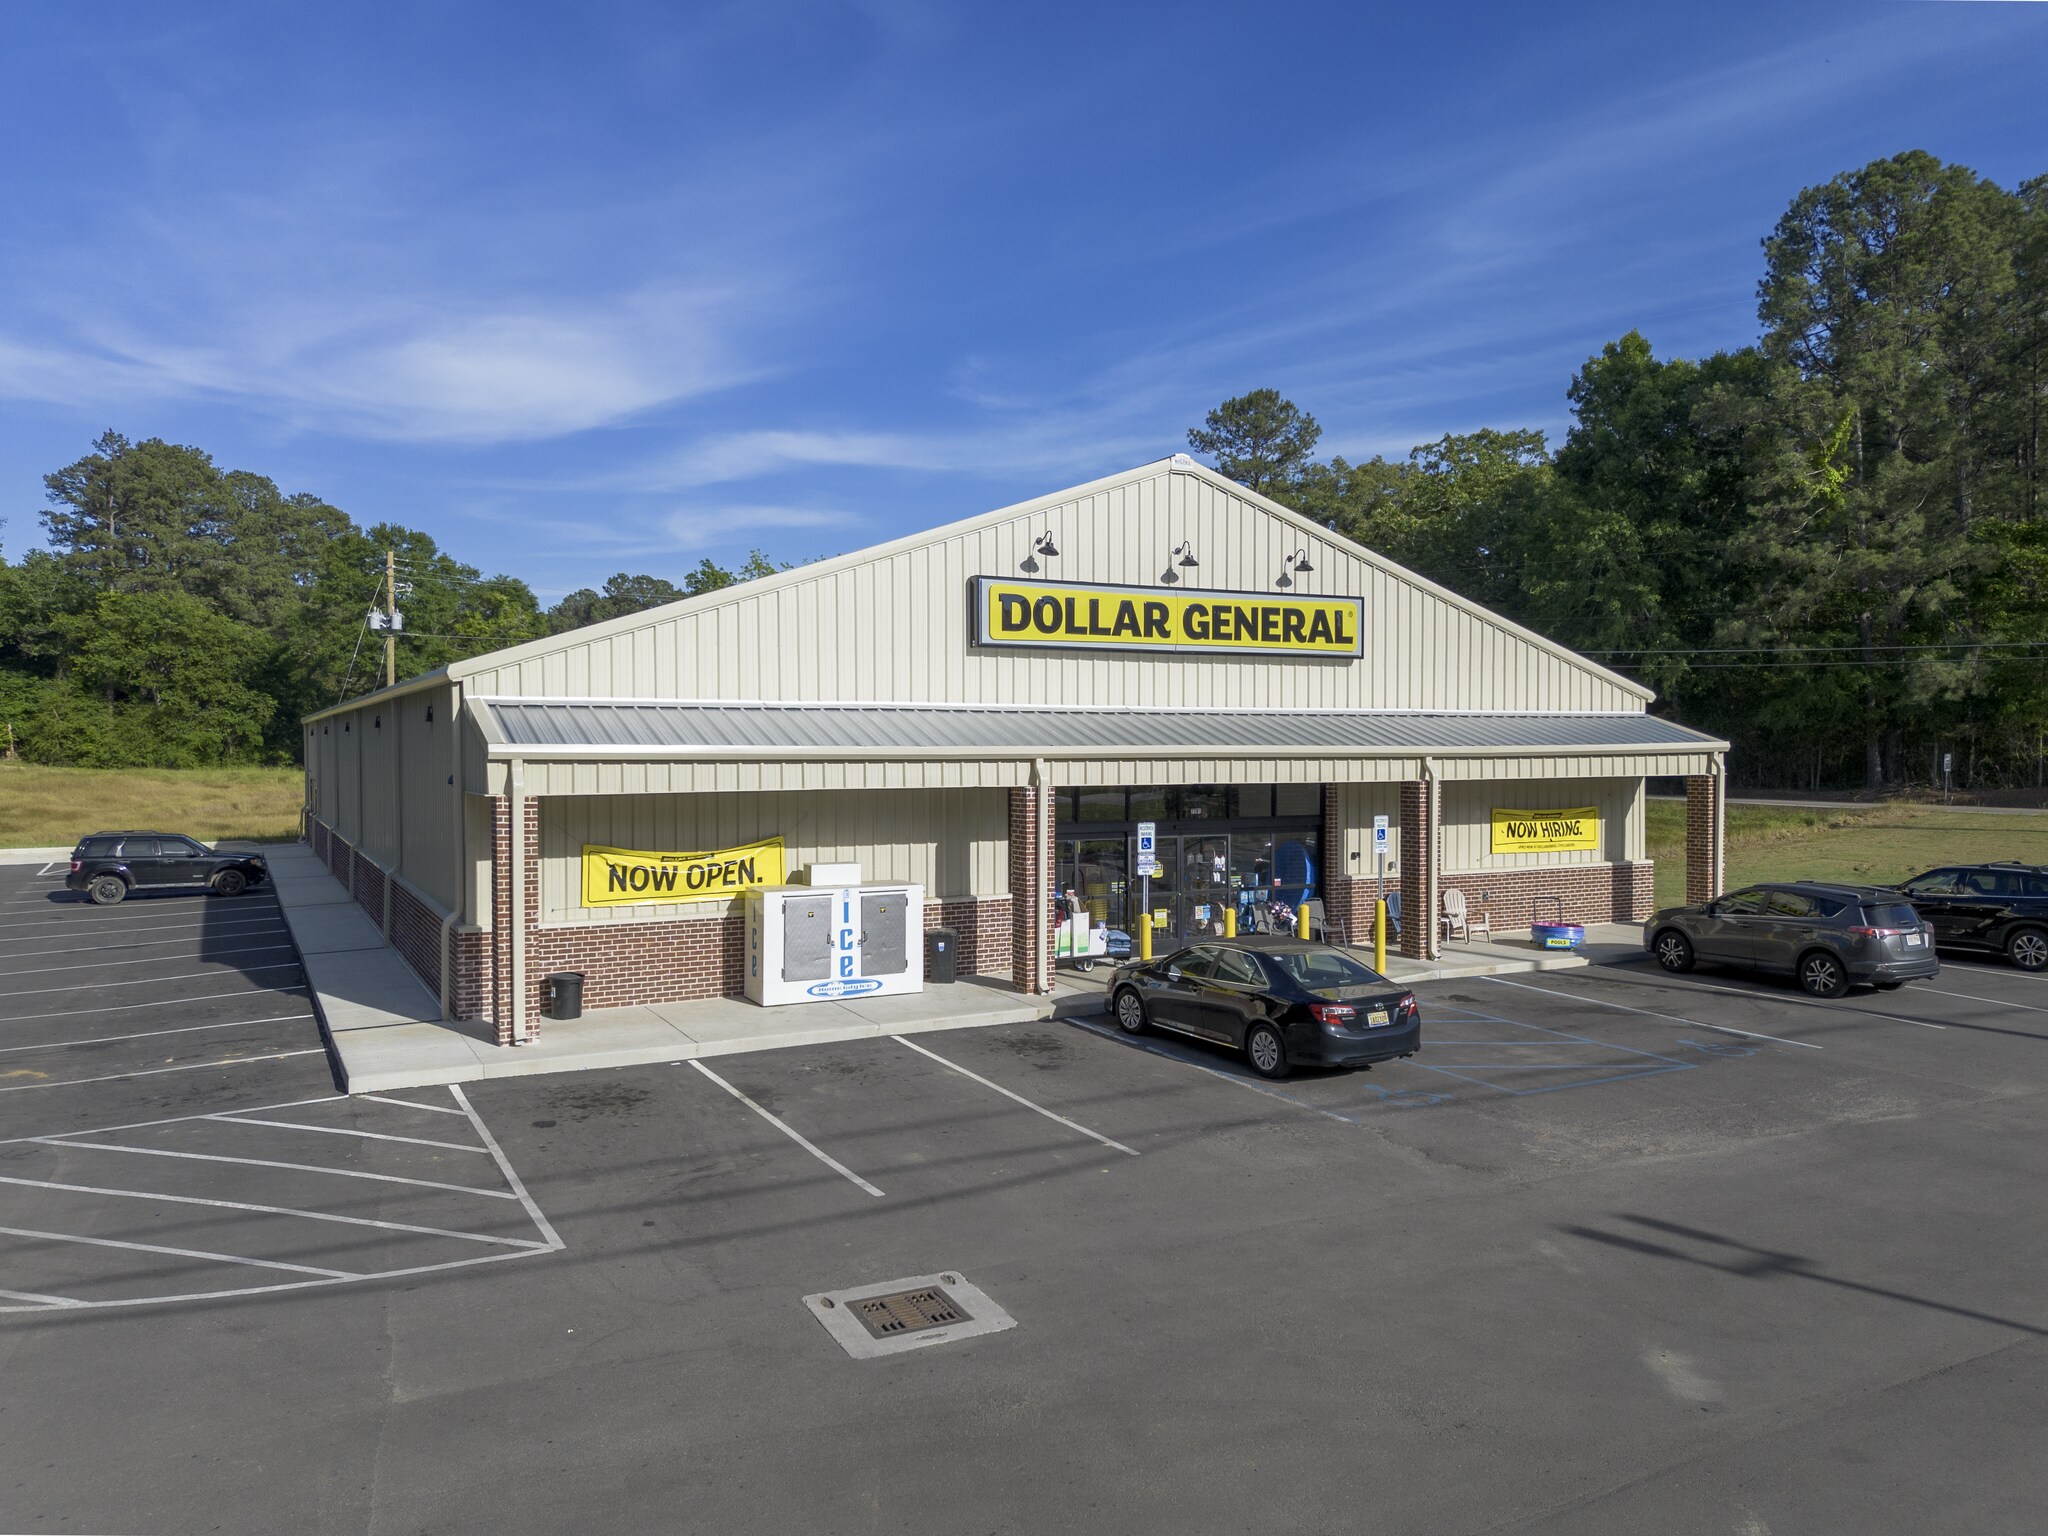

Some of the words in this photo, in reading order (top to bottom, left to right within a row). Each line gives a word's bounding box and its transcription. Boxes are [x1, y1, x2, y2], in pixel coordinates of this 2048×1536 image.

[998, 593, 1172, 640] DOLLAR
[1182, 603, 1354, 645] GENERAL
[1506, 821, 1538, 839] NOW
[1540, 820, 1583, 838] HIRING.
[608, 863, 679, 893] NOW
[686, 856, 763, 890] OPEN.
